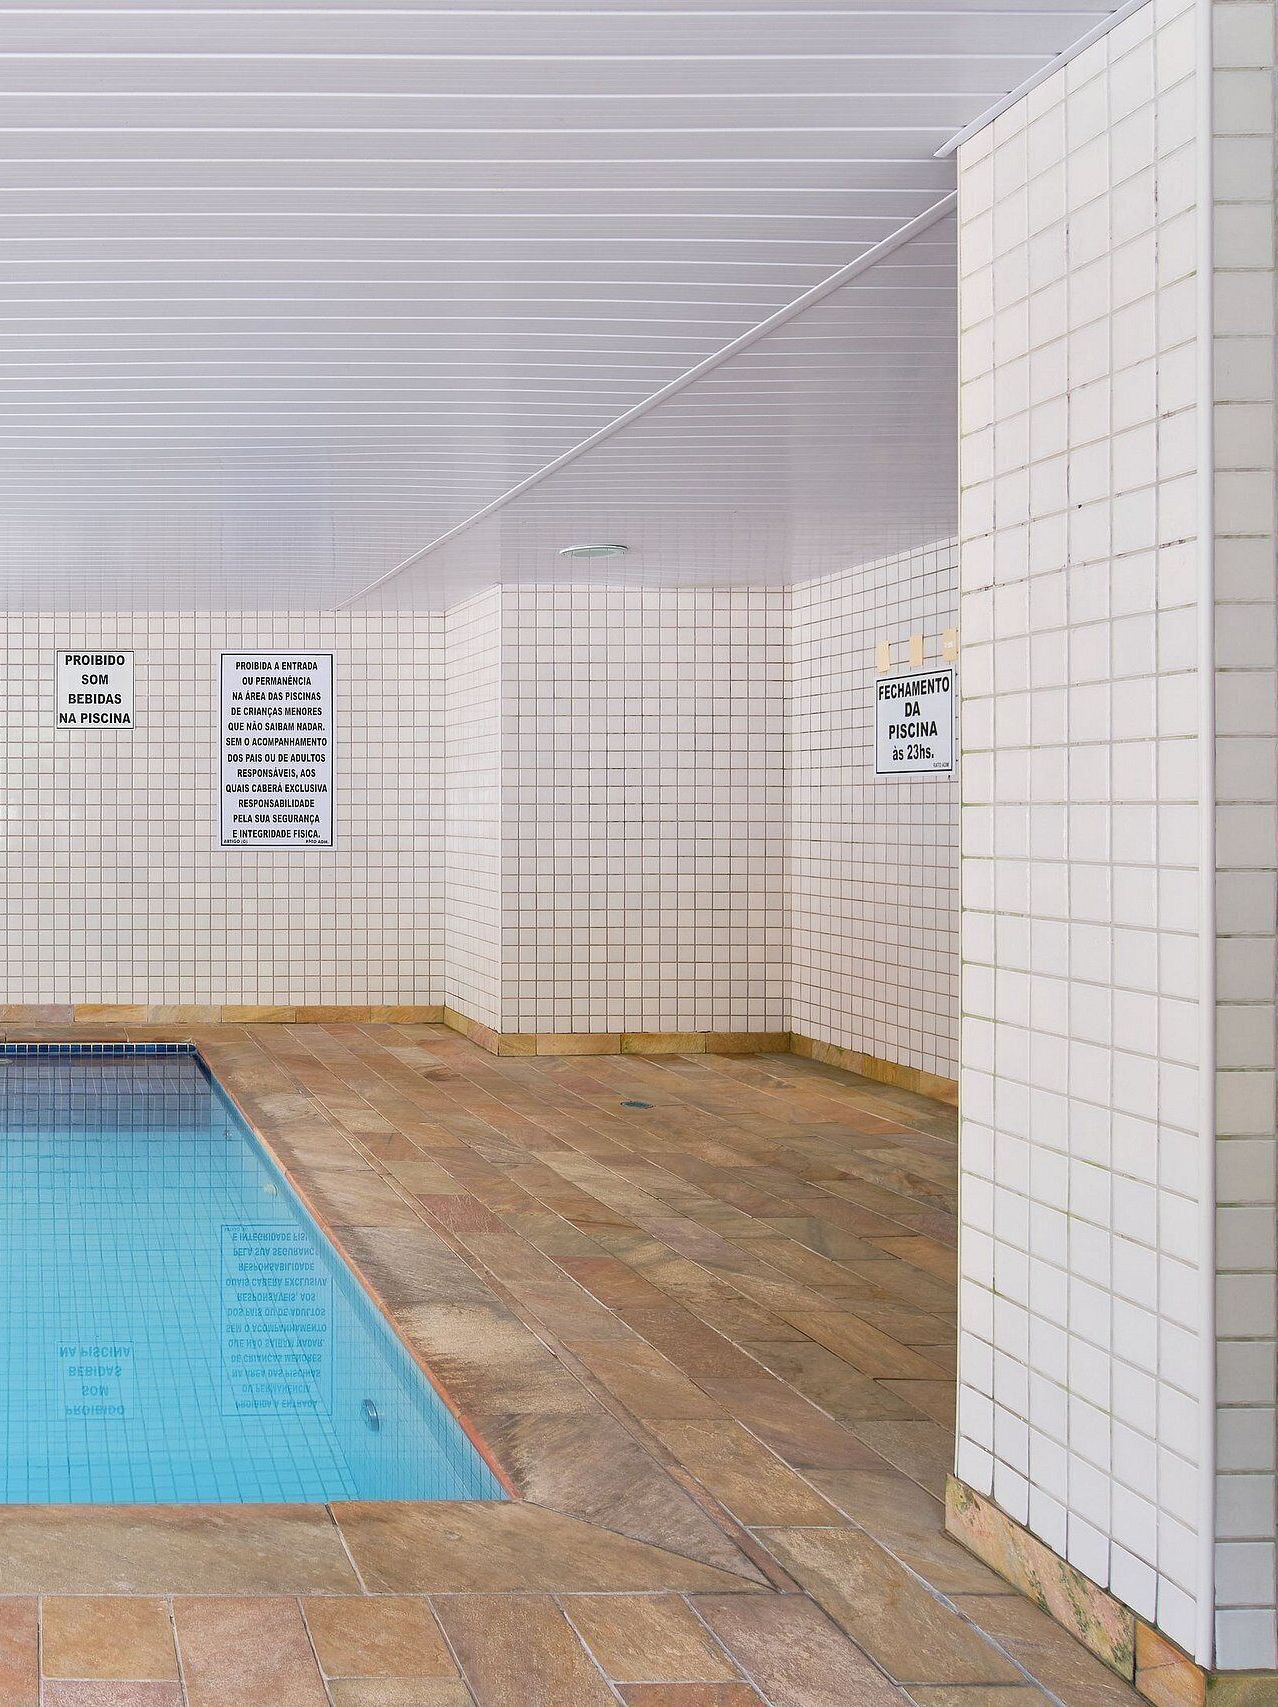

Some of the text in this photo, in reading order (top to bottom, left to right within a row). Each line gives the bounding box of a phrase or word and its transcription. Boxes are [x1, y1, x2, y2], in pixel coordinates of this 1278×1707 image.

[66, 655, 125, 665] PROIBIDO
[236, 661, 317, 670] PROIBIDA A ENTRADA
[82, 675, 108, 684] SOM
[242, 677, 253, 685] OU
[879, 677, 949, 700] FECHAMENTO
[69, 694, 121, 704] BEBIDAS
[232, 690, 321, 700] NA ÁREA DAS PISCINAS
[231, 707, 322, 717] DE CRIANÇAS MENORES
[905, 702, 920, 717] DA
[60, 713, 130, 723] NA PISCINA
[228, 721, 325, 731] QUE NÃO SAIBAM NADAR.
[889, 721, 937, 739] PISCINA
[226, 738, 327, 746] SEM O ACOMPANHAMENTO
[893, 744, 934, 760] às 23hs.
[228, 754, 325, 762] DOS PAIS OU DE ADULTOS
[237, 767, 316, 778] RESPONSÁVEIS, AOS
[226, 782, 327, 793] QUAIS CABERÁ EXCLUSIVA
[239, 799, 314, 807] RESPONSABILIDADE
[233, 814, 320, 825] PELA SUA SEGURANÇA
[233, 830, 237, 838] E
[240, 830, 291, 838] INTEGRIDADE
